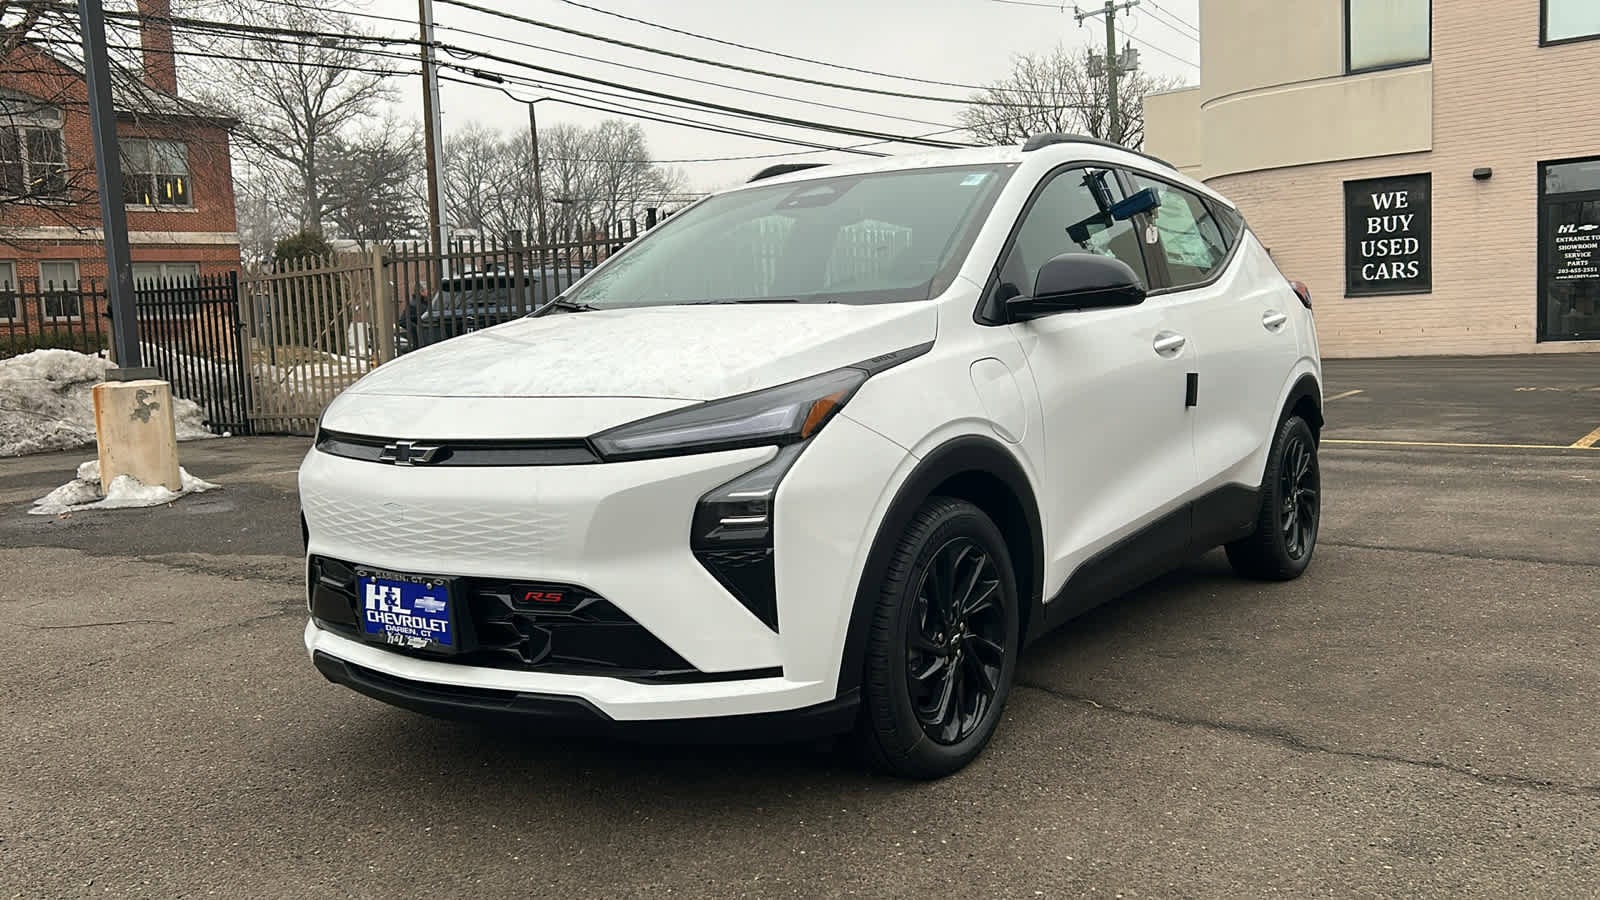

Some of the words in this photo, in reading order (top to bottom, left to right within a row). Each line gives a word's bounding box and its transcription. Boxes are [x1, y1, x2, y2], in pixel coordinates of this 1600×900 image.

[1371, 191, 1409, 210] WE
[1367, 214, 1415, 234] BUY
[1361, 238, 1419, 257] USED
[1362, 261, 1419, 280] CARS
[366, 584, 411, 614] H&L
[524, 591, 563, 602] RS
[367, 611, 448, 632] CHEVROLET
